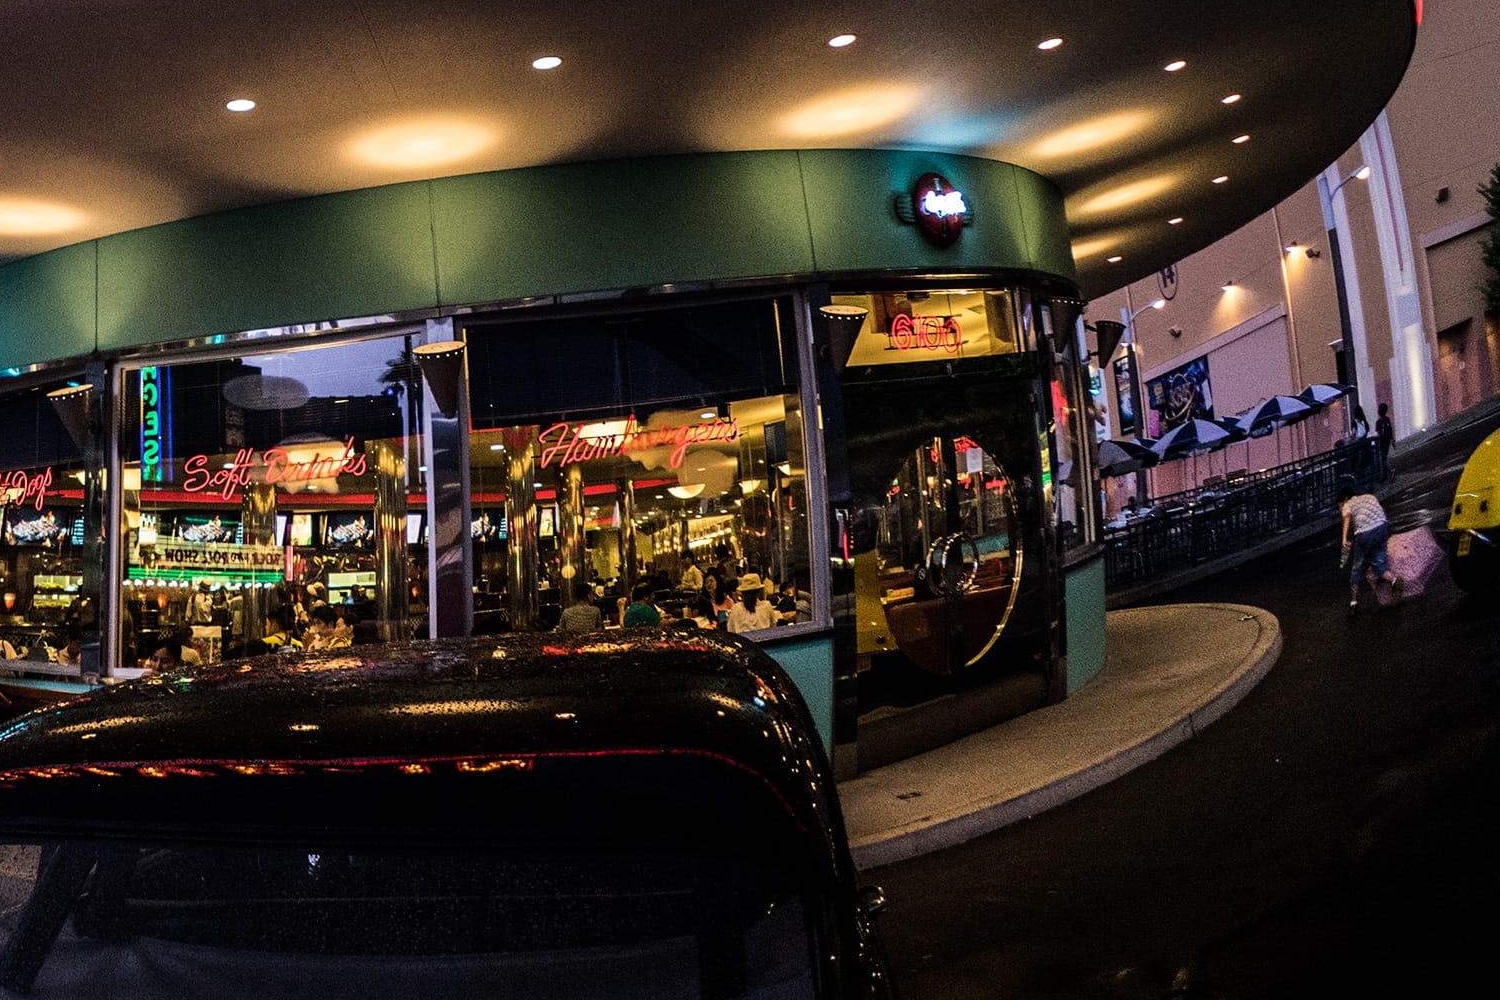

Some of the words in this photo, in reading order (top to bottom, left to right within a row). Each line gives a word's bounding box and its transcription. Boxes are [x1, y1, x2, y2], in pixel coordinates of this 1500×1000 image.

[183, 447, 255, 500] Soft
[263, 435, 367, 483] Drinks
[538, 413, 740, 469] Hamburgers
[11, 466, 52, 510] Dogs
